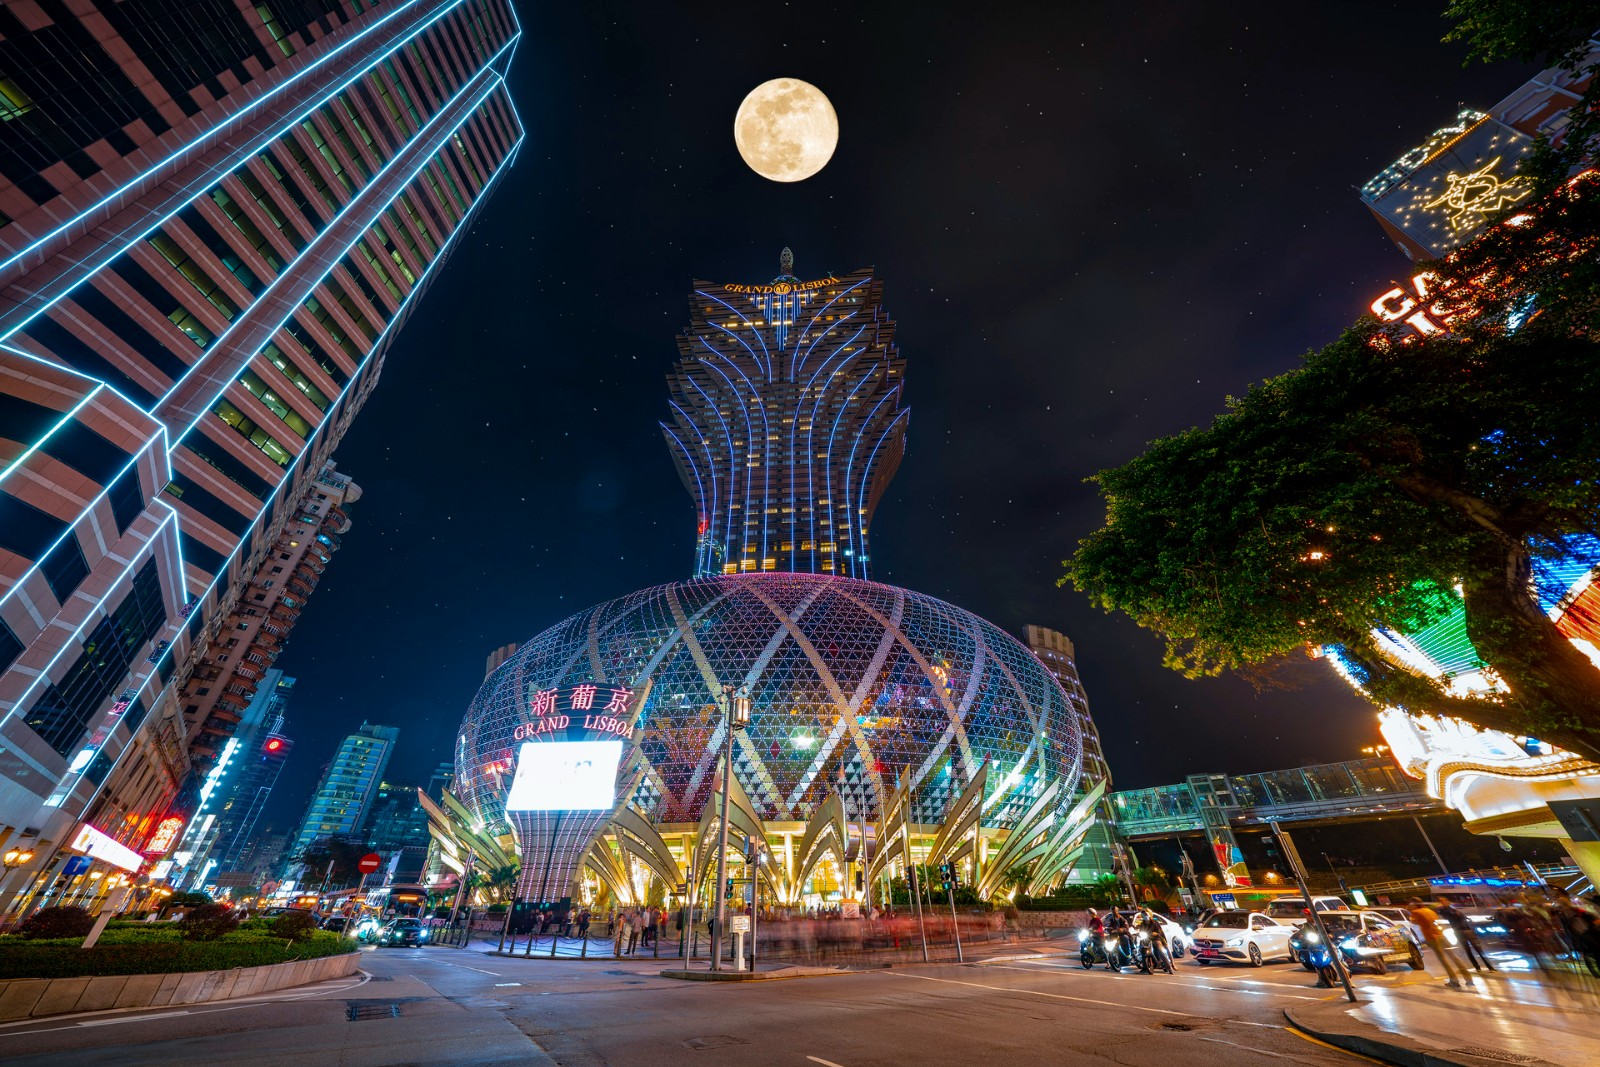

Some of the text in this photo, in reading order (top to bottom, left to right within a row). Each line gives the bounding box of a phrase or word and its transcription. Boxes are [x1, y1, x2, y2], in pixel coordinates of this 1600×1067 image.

[724, 277, 840, 294] GRAND LISBOA
[530, 684, 634, 717] 新葡京
[514, 714, 634, 740] GRAND LISBOA
